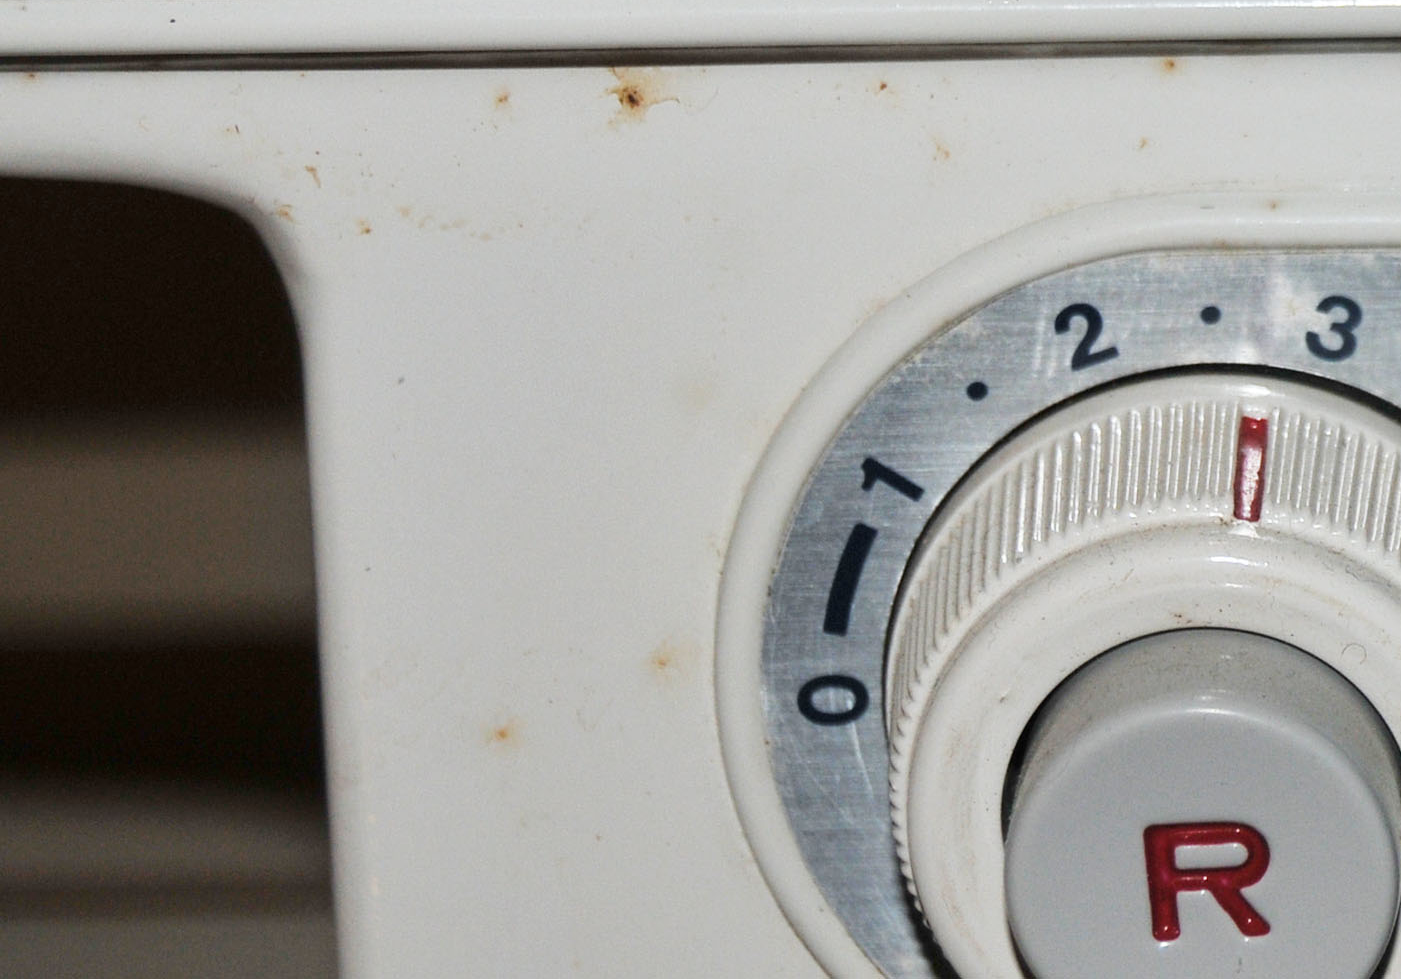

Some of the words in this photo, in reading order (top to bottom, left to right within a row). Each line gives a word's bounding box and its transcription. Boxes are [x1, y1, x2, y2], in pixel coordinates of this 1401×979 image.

[1054, 303, 1119, 371] 2
[1305, 295, 1363, 362] 3
[861, 457, 924, 502] 1
[1145, 825, 1270, 941] R
